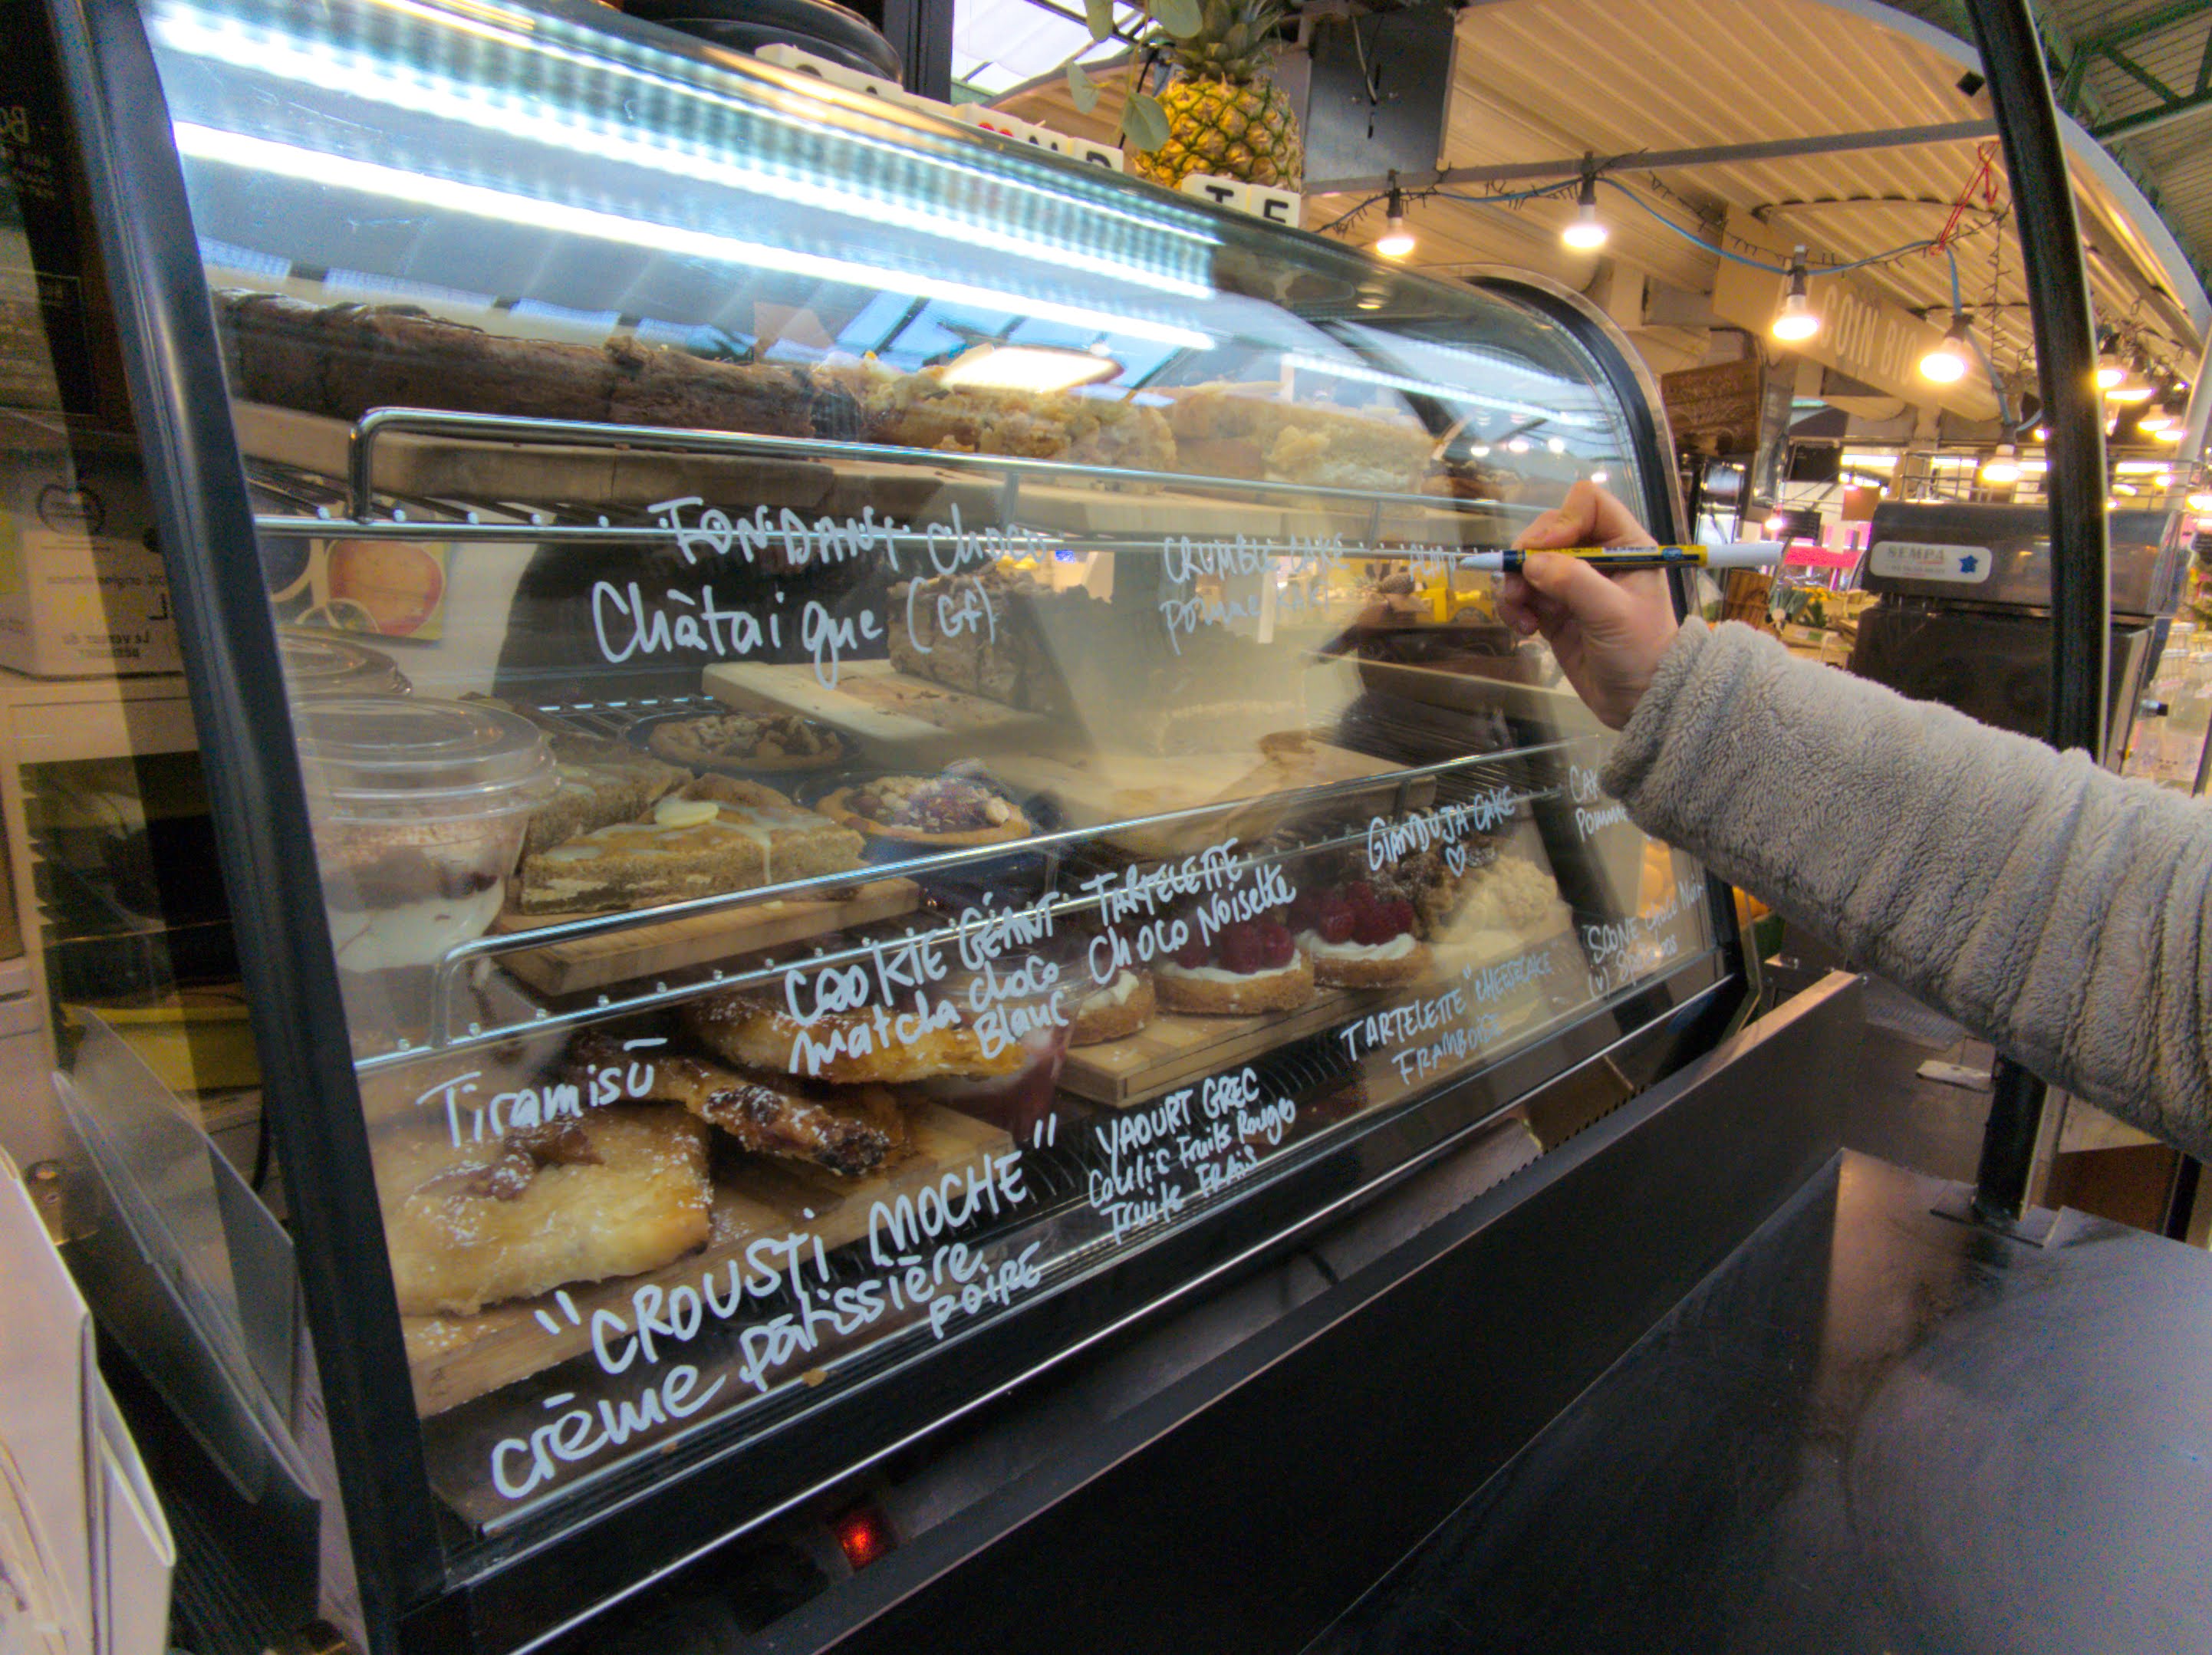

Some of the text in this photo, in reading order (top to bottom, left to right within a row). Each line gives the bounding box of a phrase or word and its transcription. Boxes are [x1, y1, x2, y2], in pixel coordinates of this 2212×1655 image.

[1473, 785, 1516, 831] CAKE
[1080, 837, 1243, 926] TARTELETTE
[784, 929, 948, 1027] COOKIE
[1339, 987, 1467, 1062] TARTELETTE
[1202, 1067, 1259, 1120] GREC
